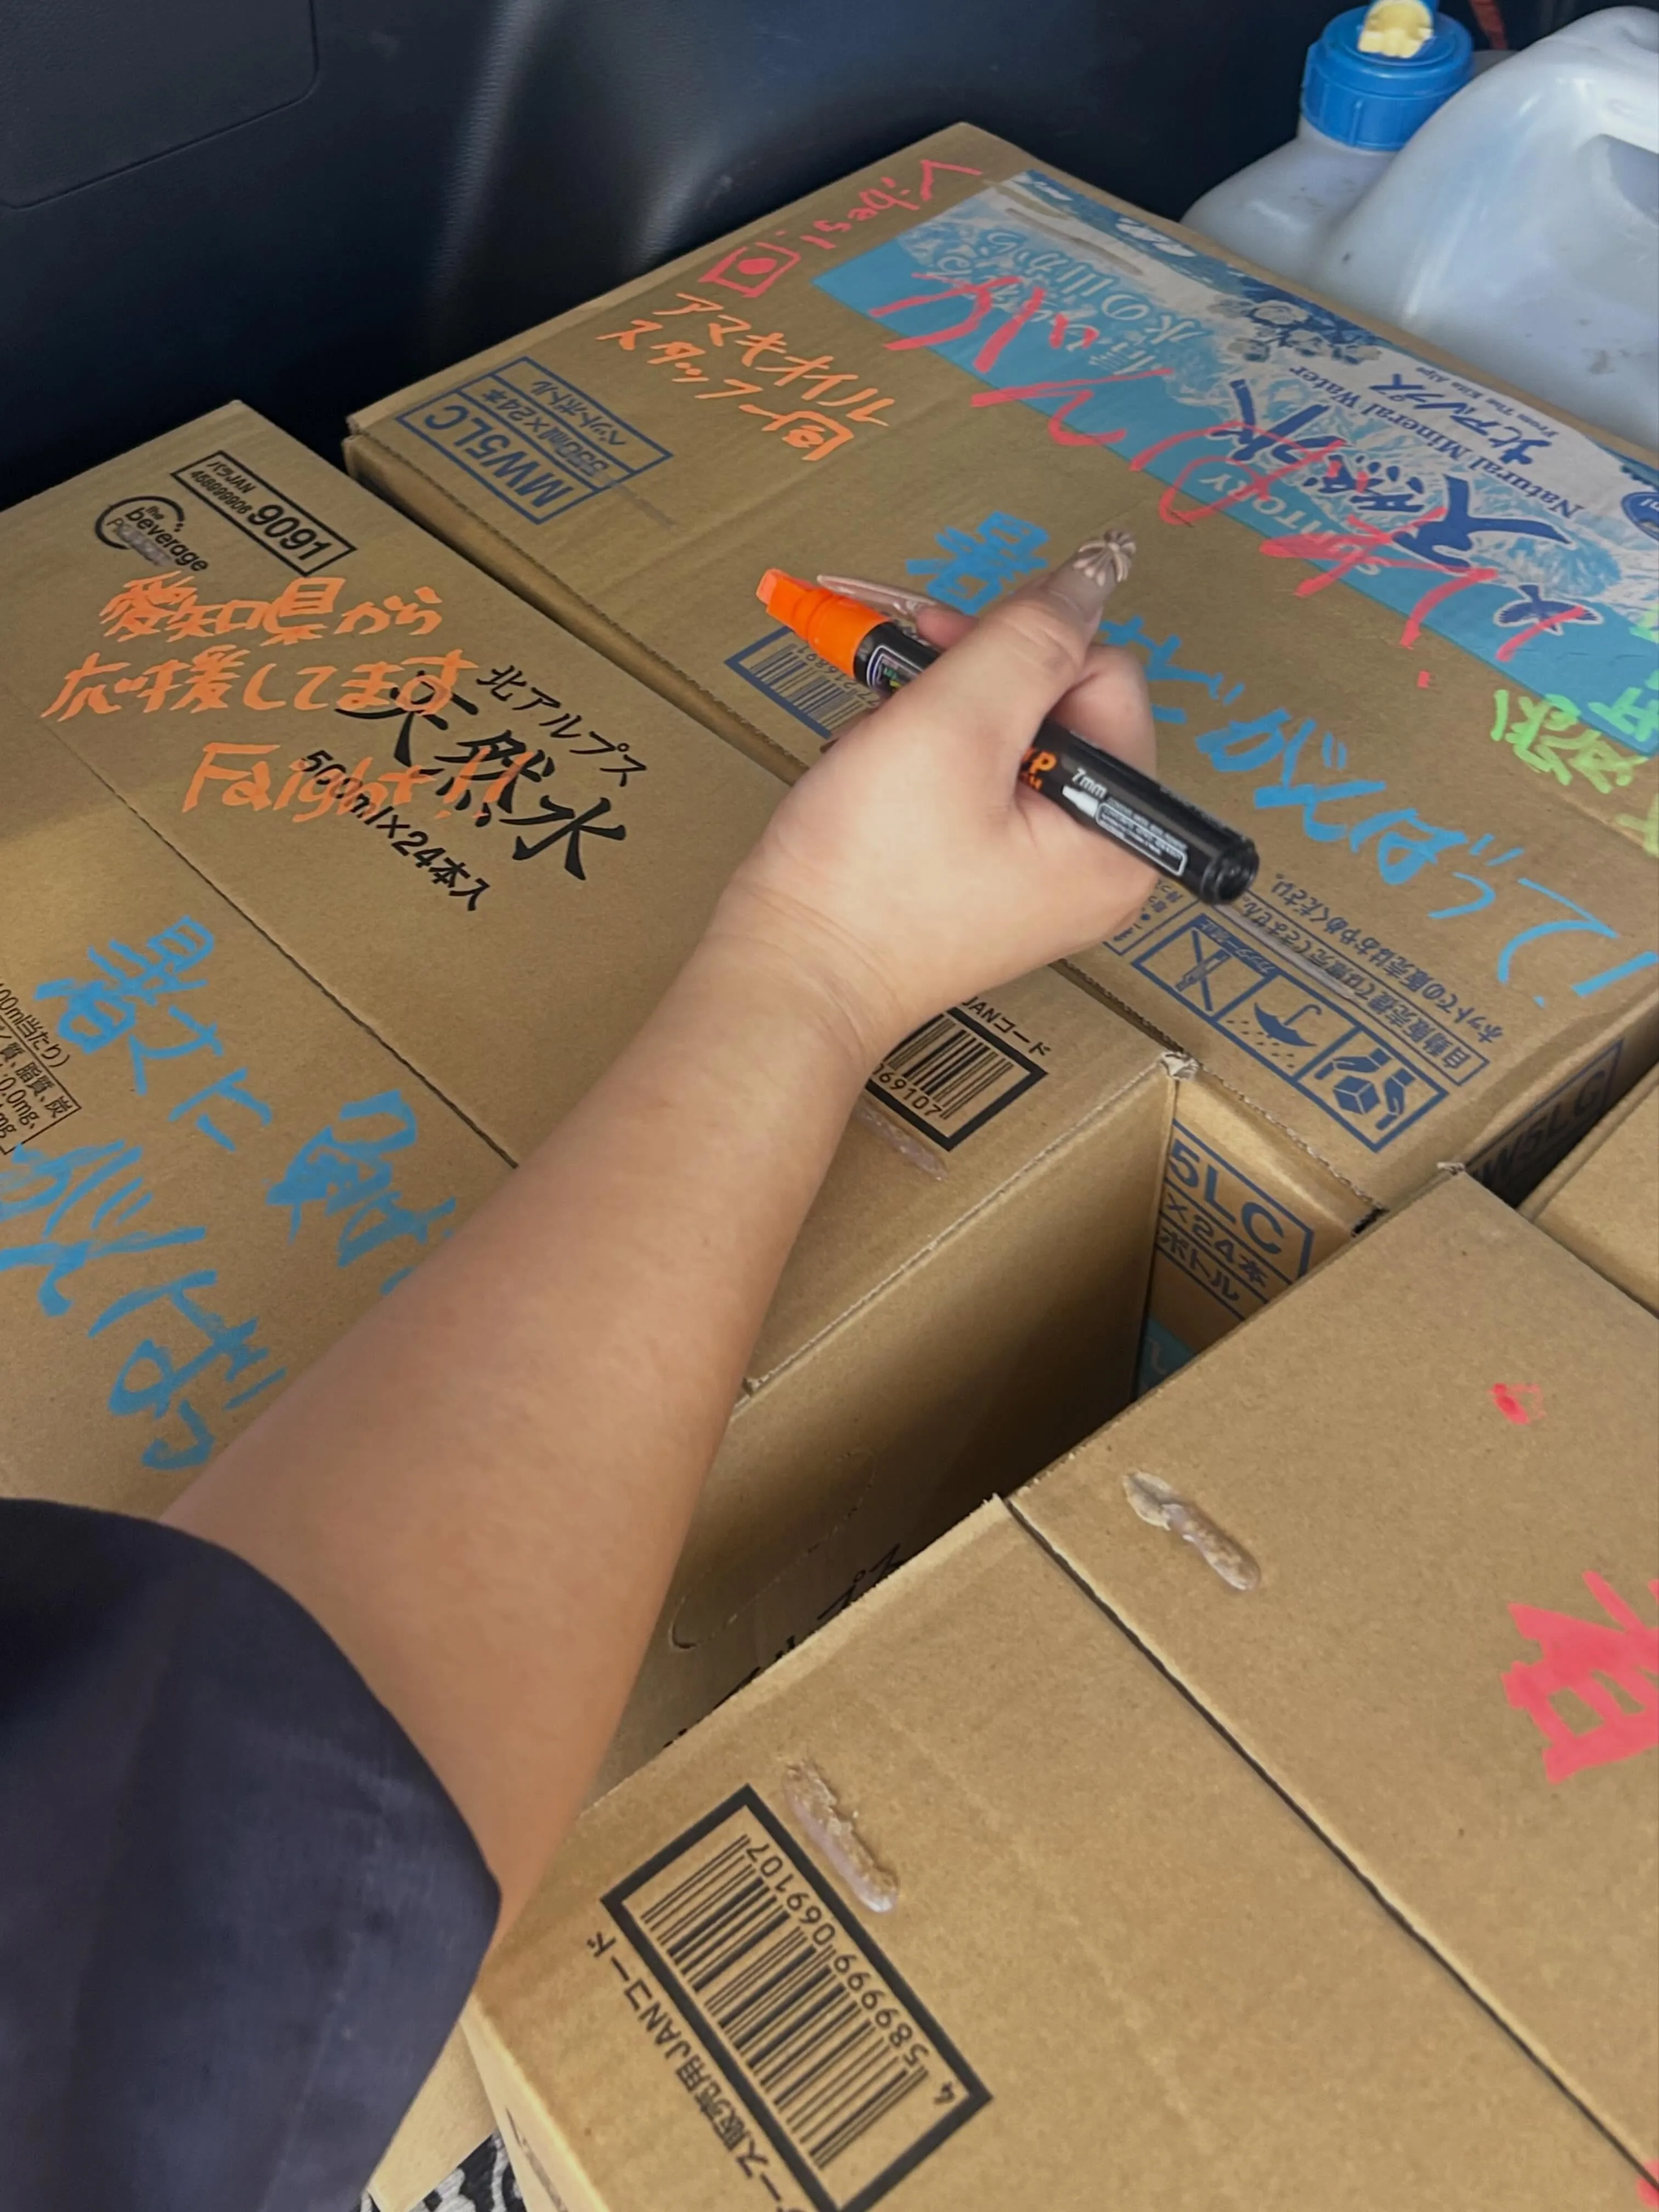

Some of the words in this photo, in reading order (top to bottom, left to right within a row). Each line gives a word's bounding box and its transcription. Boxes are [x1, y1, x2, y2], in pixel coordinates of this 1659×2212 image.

[986, 230, 1205, 345] 水の山から
[531, 380, 628, 447] ペットボトル
[1289, 365, 1362, 417] Water
[1360, 399, 1471, 465] Mineral
[1370, 373, 1553, 465] 北アルプス
[206, 461, 256, 495] バラJAN
[424, 404, 574, 509] MW5LC
[1209, 379, 1573, 571] 天然水
[1468, 456, 1586, 519] Natural
[125, 506, 209, 572] beverage
[146, 505, 165, 521] the
[248, 502, 334, 563] 9091
[99, 571, 442, 646] 愛知県から
[41, 643, 479, 722] 応援してます
[476, 665, 647, 788] 北アルプス
[334, 670, 627, 881] 天然水
[1071, 766, 1108, 799] 7mm
[1272, 873, 1505, 1044] ホットでの販売はおやめください。
[0, 983, 70, 1068] 00ml当たり)
[744, 1842, 838, 1947] 069107
[833, 1953, 931, 2068] 589999
[586, 1930, 795, 2212] ース販売用JANコード
